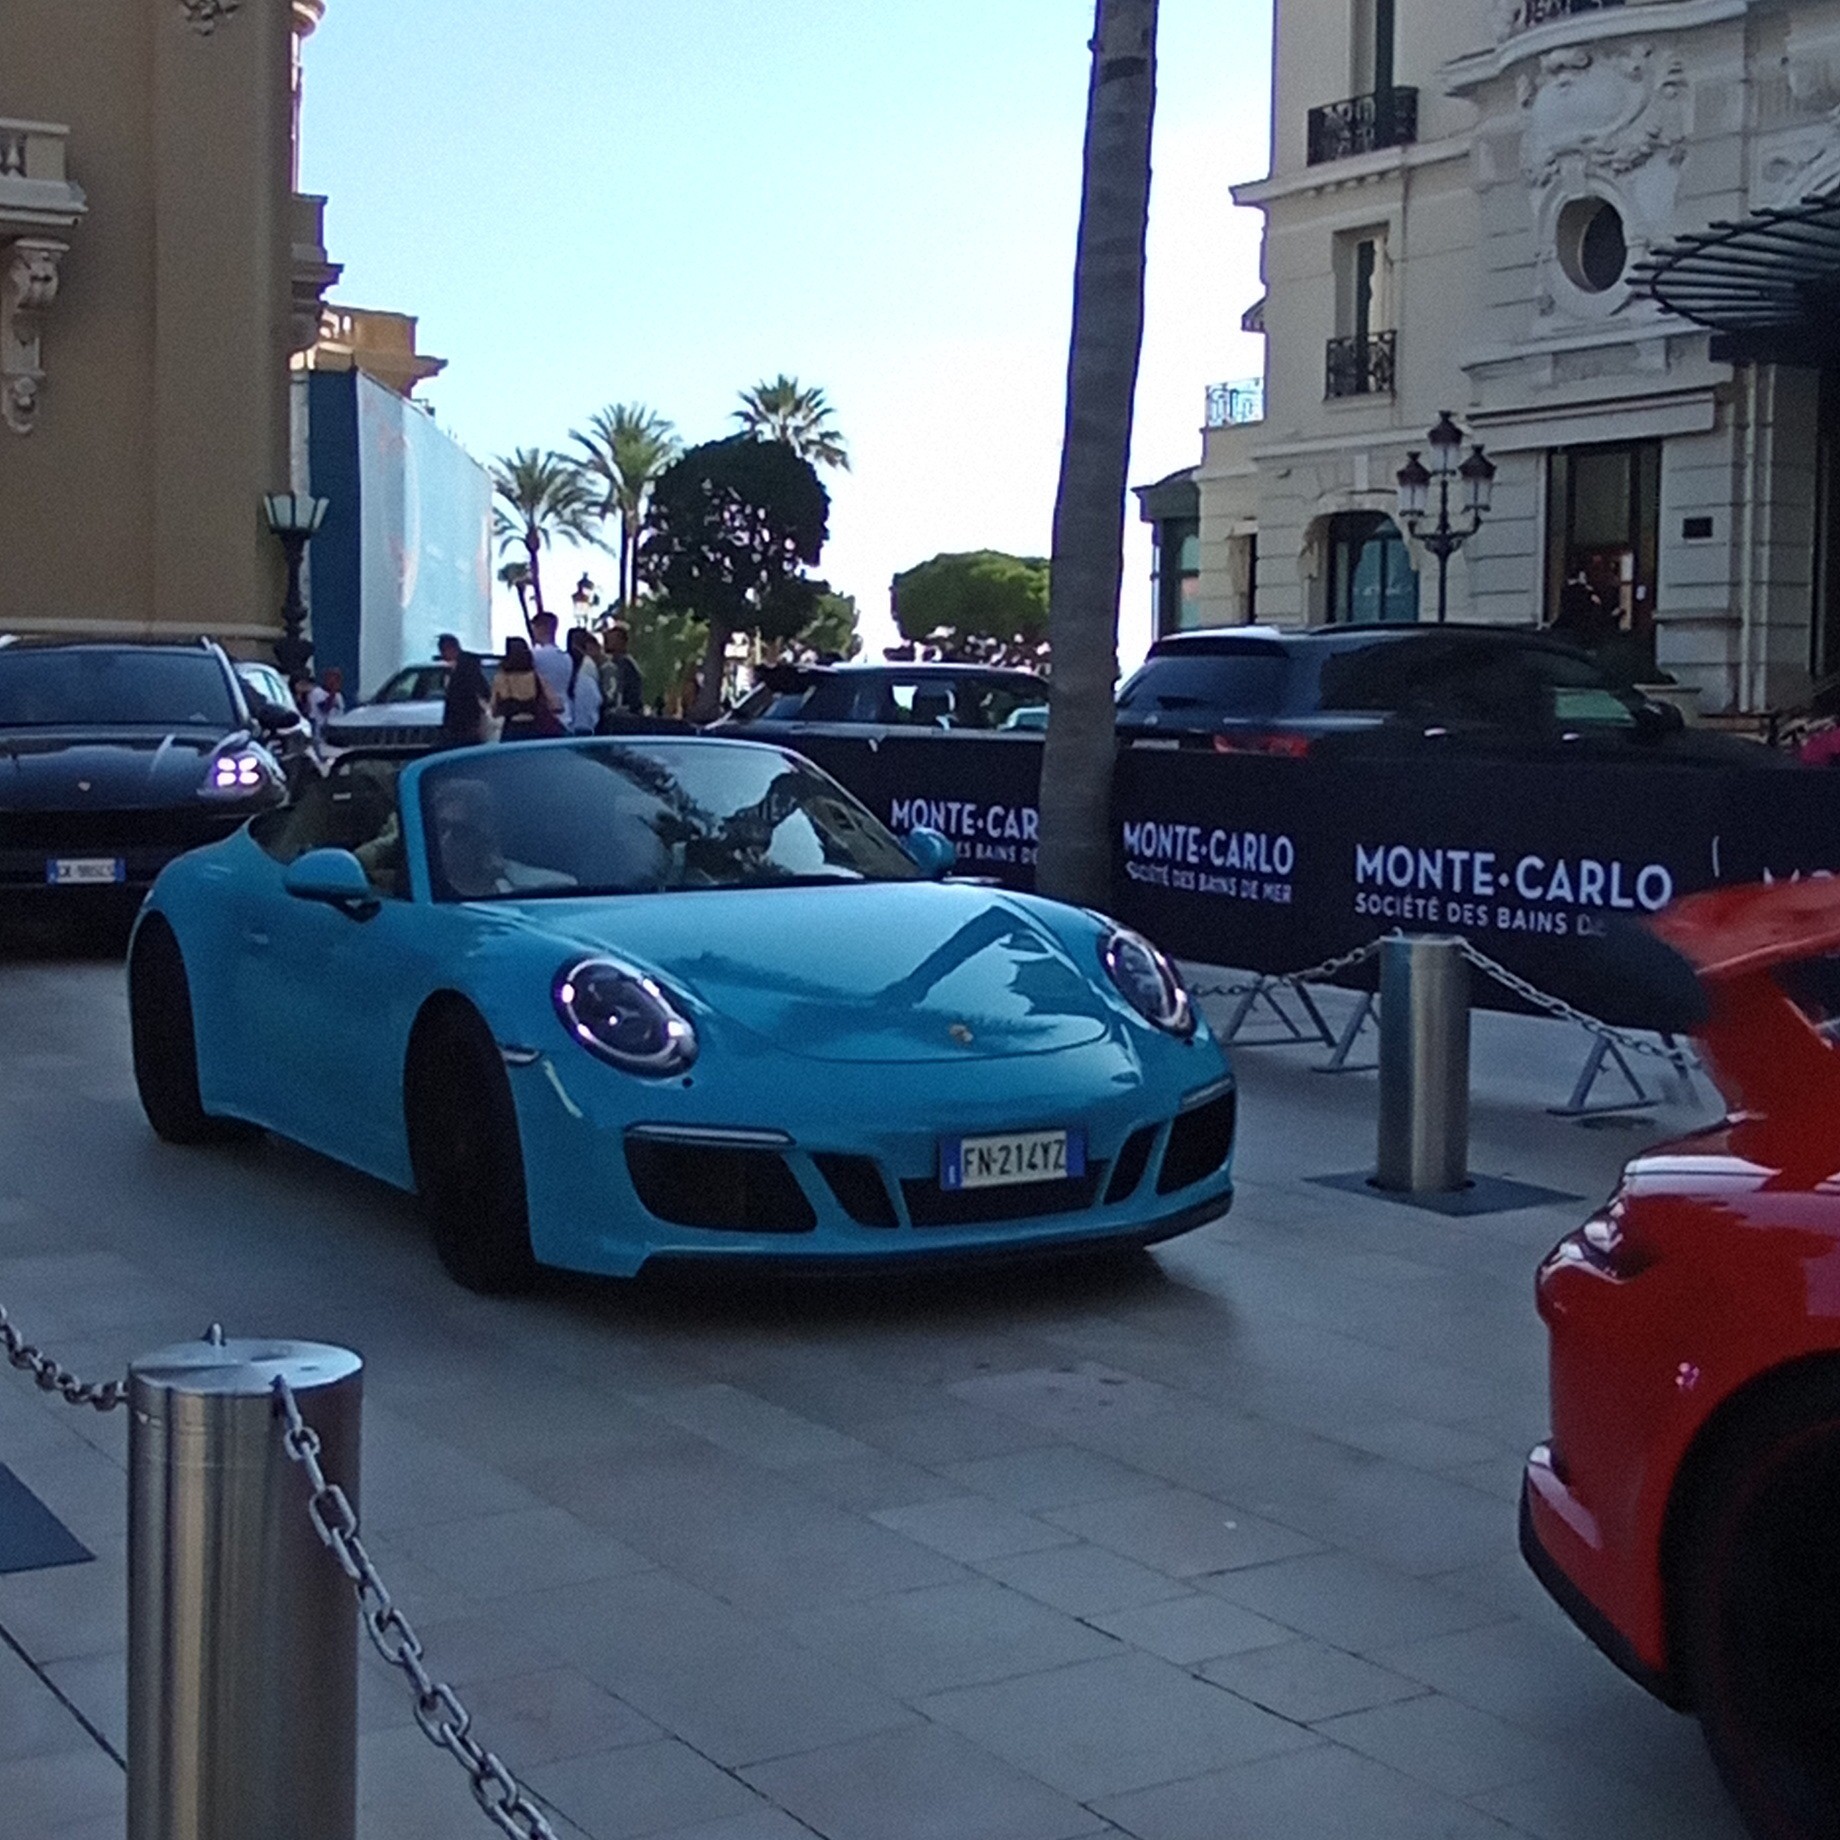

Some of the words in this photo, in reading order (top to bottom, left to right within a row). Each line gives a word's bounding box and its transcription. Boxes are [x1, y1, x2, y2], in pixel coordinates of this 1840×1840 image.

[1123, 821, 1295, 876] MONTE·CARLO
[1355, 843, 1673, 911] MONTE·CARLO
[1354, 891, 1440, 922] SOCIÉTÉ
[1447, 901, 1489, 927] DES
[1496, 907, 1568, 936] BAINS
